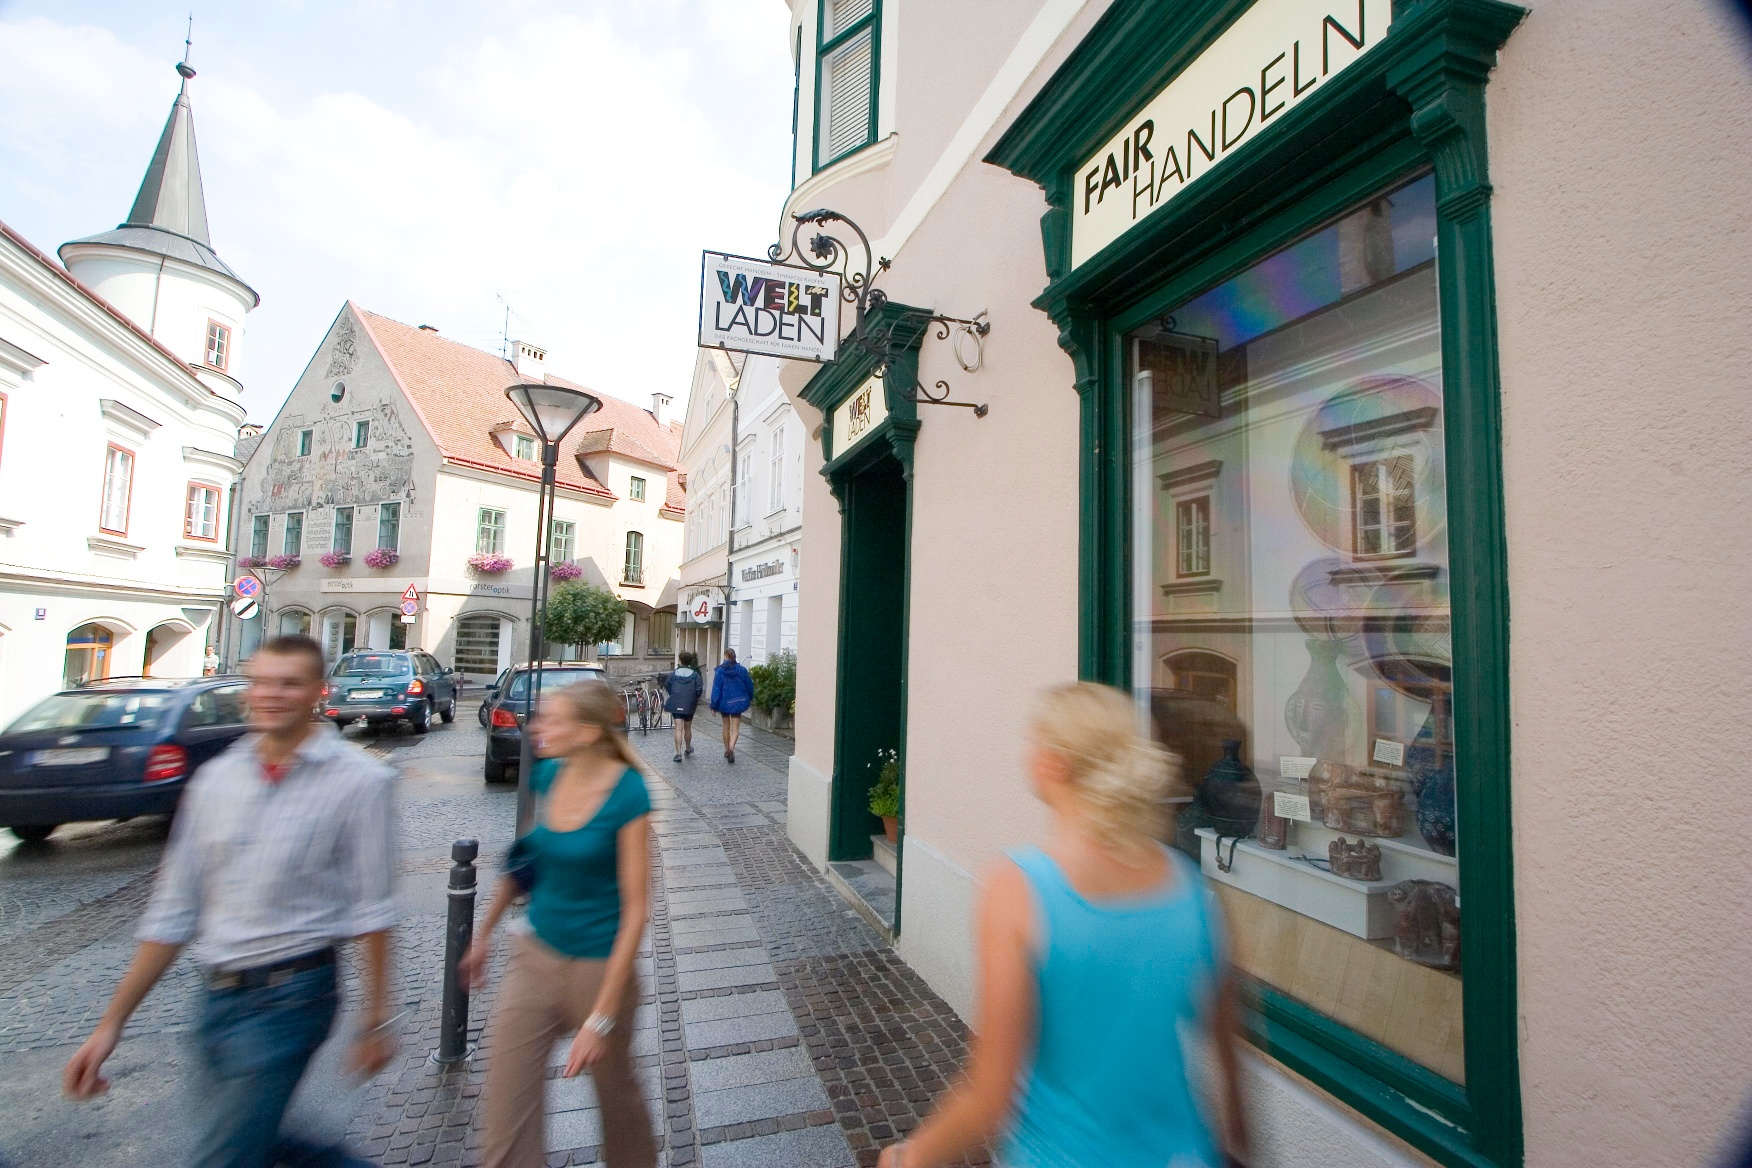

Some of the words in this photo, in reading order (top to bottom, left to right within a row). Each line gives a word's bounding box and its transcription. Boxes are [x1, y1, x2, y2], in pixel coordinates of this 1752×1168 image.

[1132, 0, 1365, 220] HANDELN
[1084, 119, 1155, 216] FAIR
[716, 269, 829, 318] WELT
[718, 263, 743, 272] GERECHT
[744, 266, 772, 277] HANDELN
[803, 276, 826, 285] KAUFEN
[715, 300, 825, 346] LADEN
[800, 345, 823, 354] HANDEL
